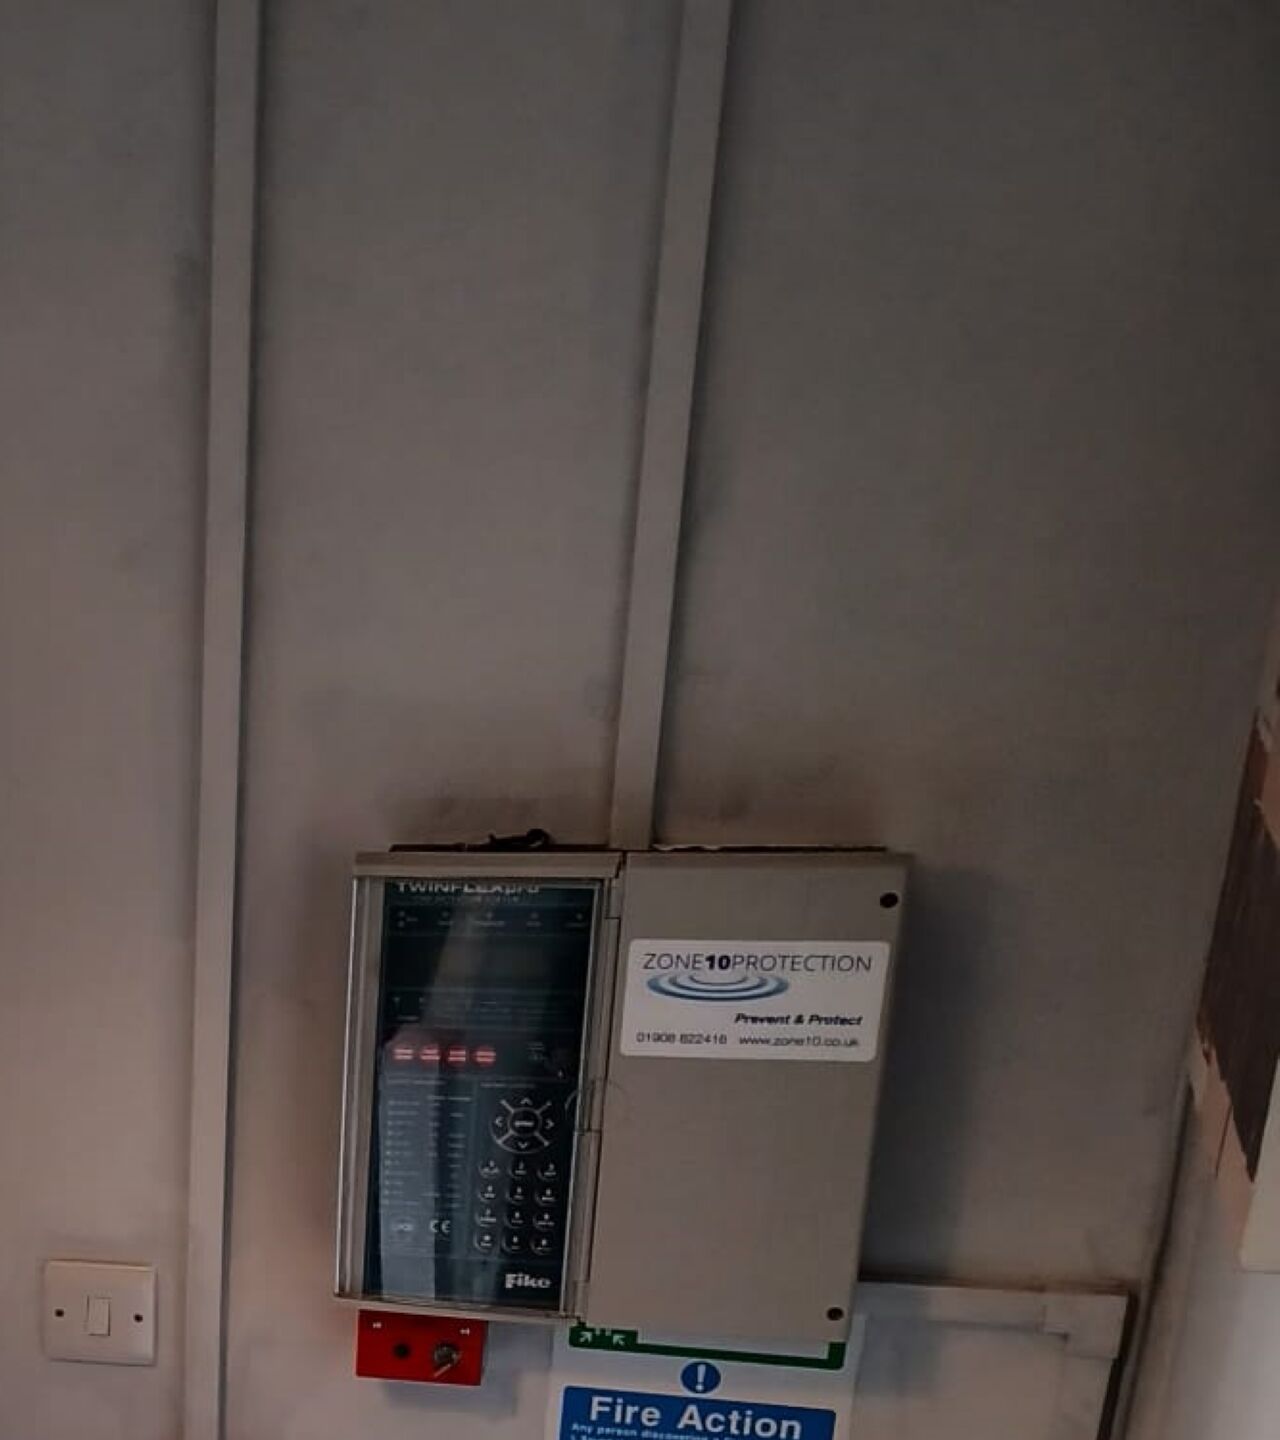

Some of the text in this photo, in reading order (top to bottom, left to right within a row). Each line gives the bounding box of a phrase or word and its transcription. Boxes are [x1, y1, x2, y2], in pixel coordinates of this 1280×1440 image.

[641, 952, 874, 972] ZONE10PROTECTION
[734, 1013, 863, 1026] Prevent & Protect
[739, 1035, 860, 1048] www.zone10.co.uk
[589, 1396, 802, 1440] Fire Action
[571, 1423, 592, 1433] Any
[597, 1427, 638, 1437] person
